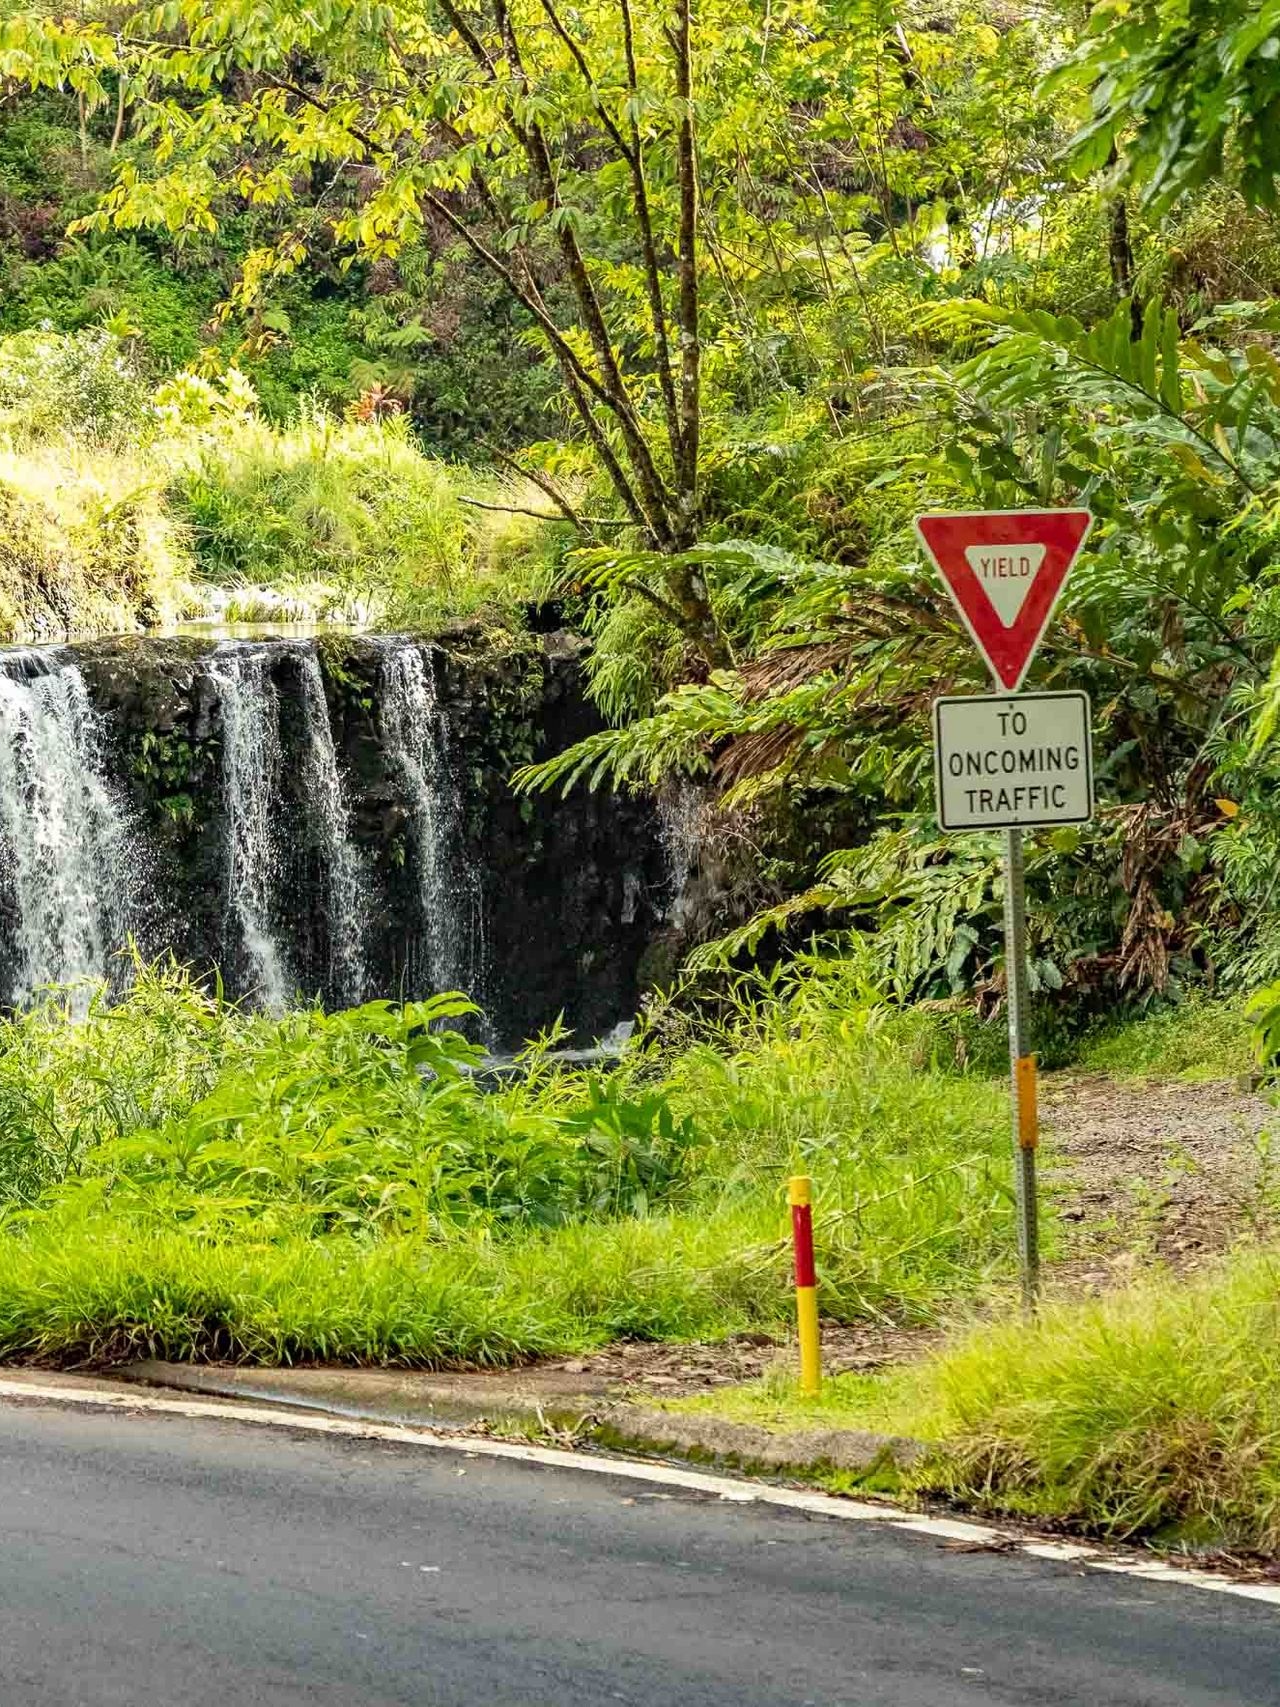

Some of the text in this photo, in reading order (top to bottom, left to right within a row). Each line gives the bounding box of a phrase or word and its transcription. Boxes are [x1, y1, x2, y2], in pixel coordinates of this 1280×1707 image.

[979, 557, 1031, 579] YIELD
[997, 711, 1027, 737] TO
[949, 746, 1079, 777] ONCOMING
[964, 784, 1066, 814] TRAFFIC
